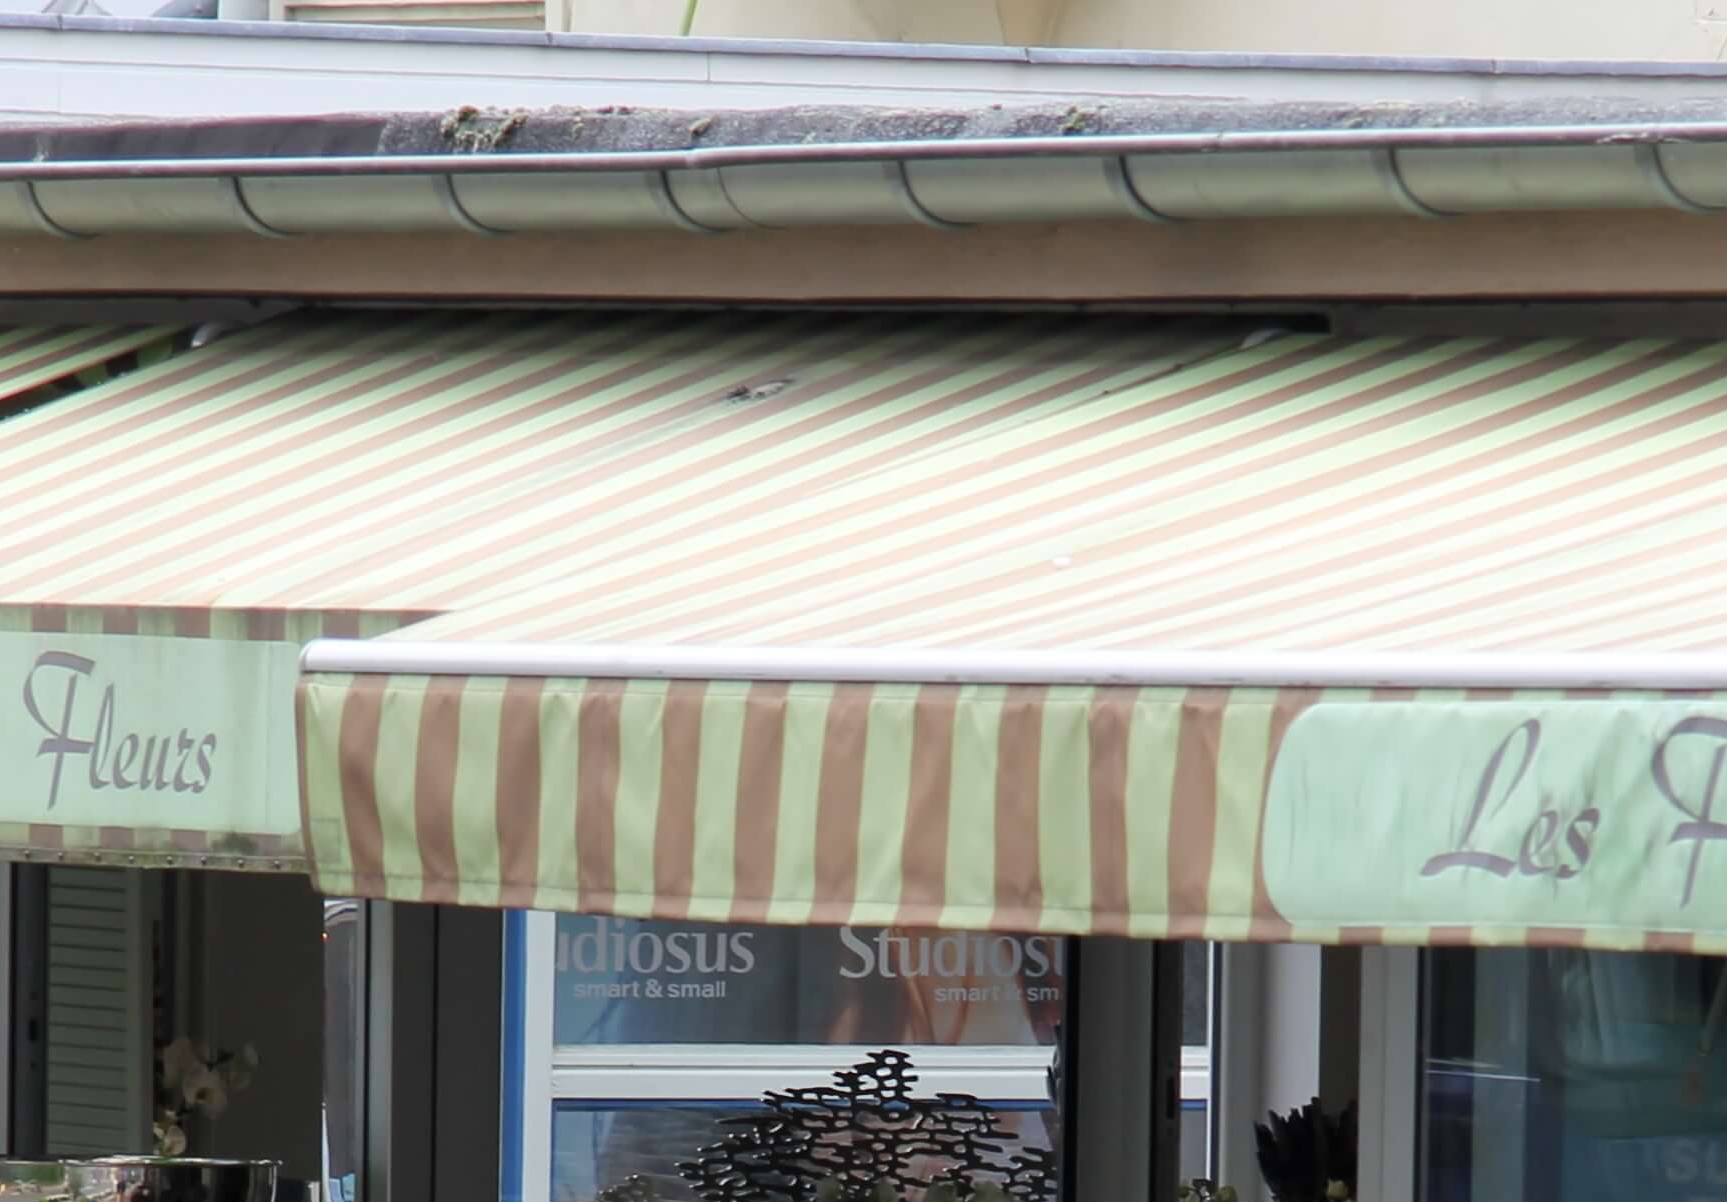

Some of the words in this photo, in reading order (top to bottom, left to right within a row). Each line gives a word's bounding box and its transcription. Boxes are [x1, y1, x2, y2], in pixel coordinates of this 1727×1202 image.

[23, 650, 217, 811] Fleurs
[1419, 717, 1601, 880] Les
[574, 981, 640, 998] smart
[645, 979, 663, 998] &
[667, 981, 726, 998] small
